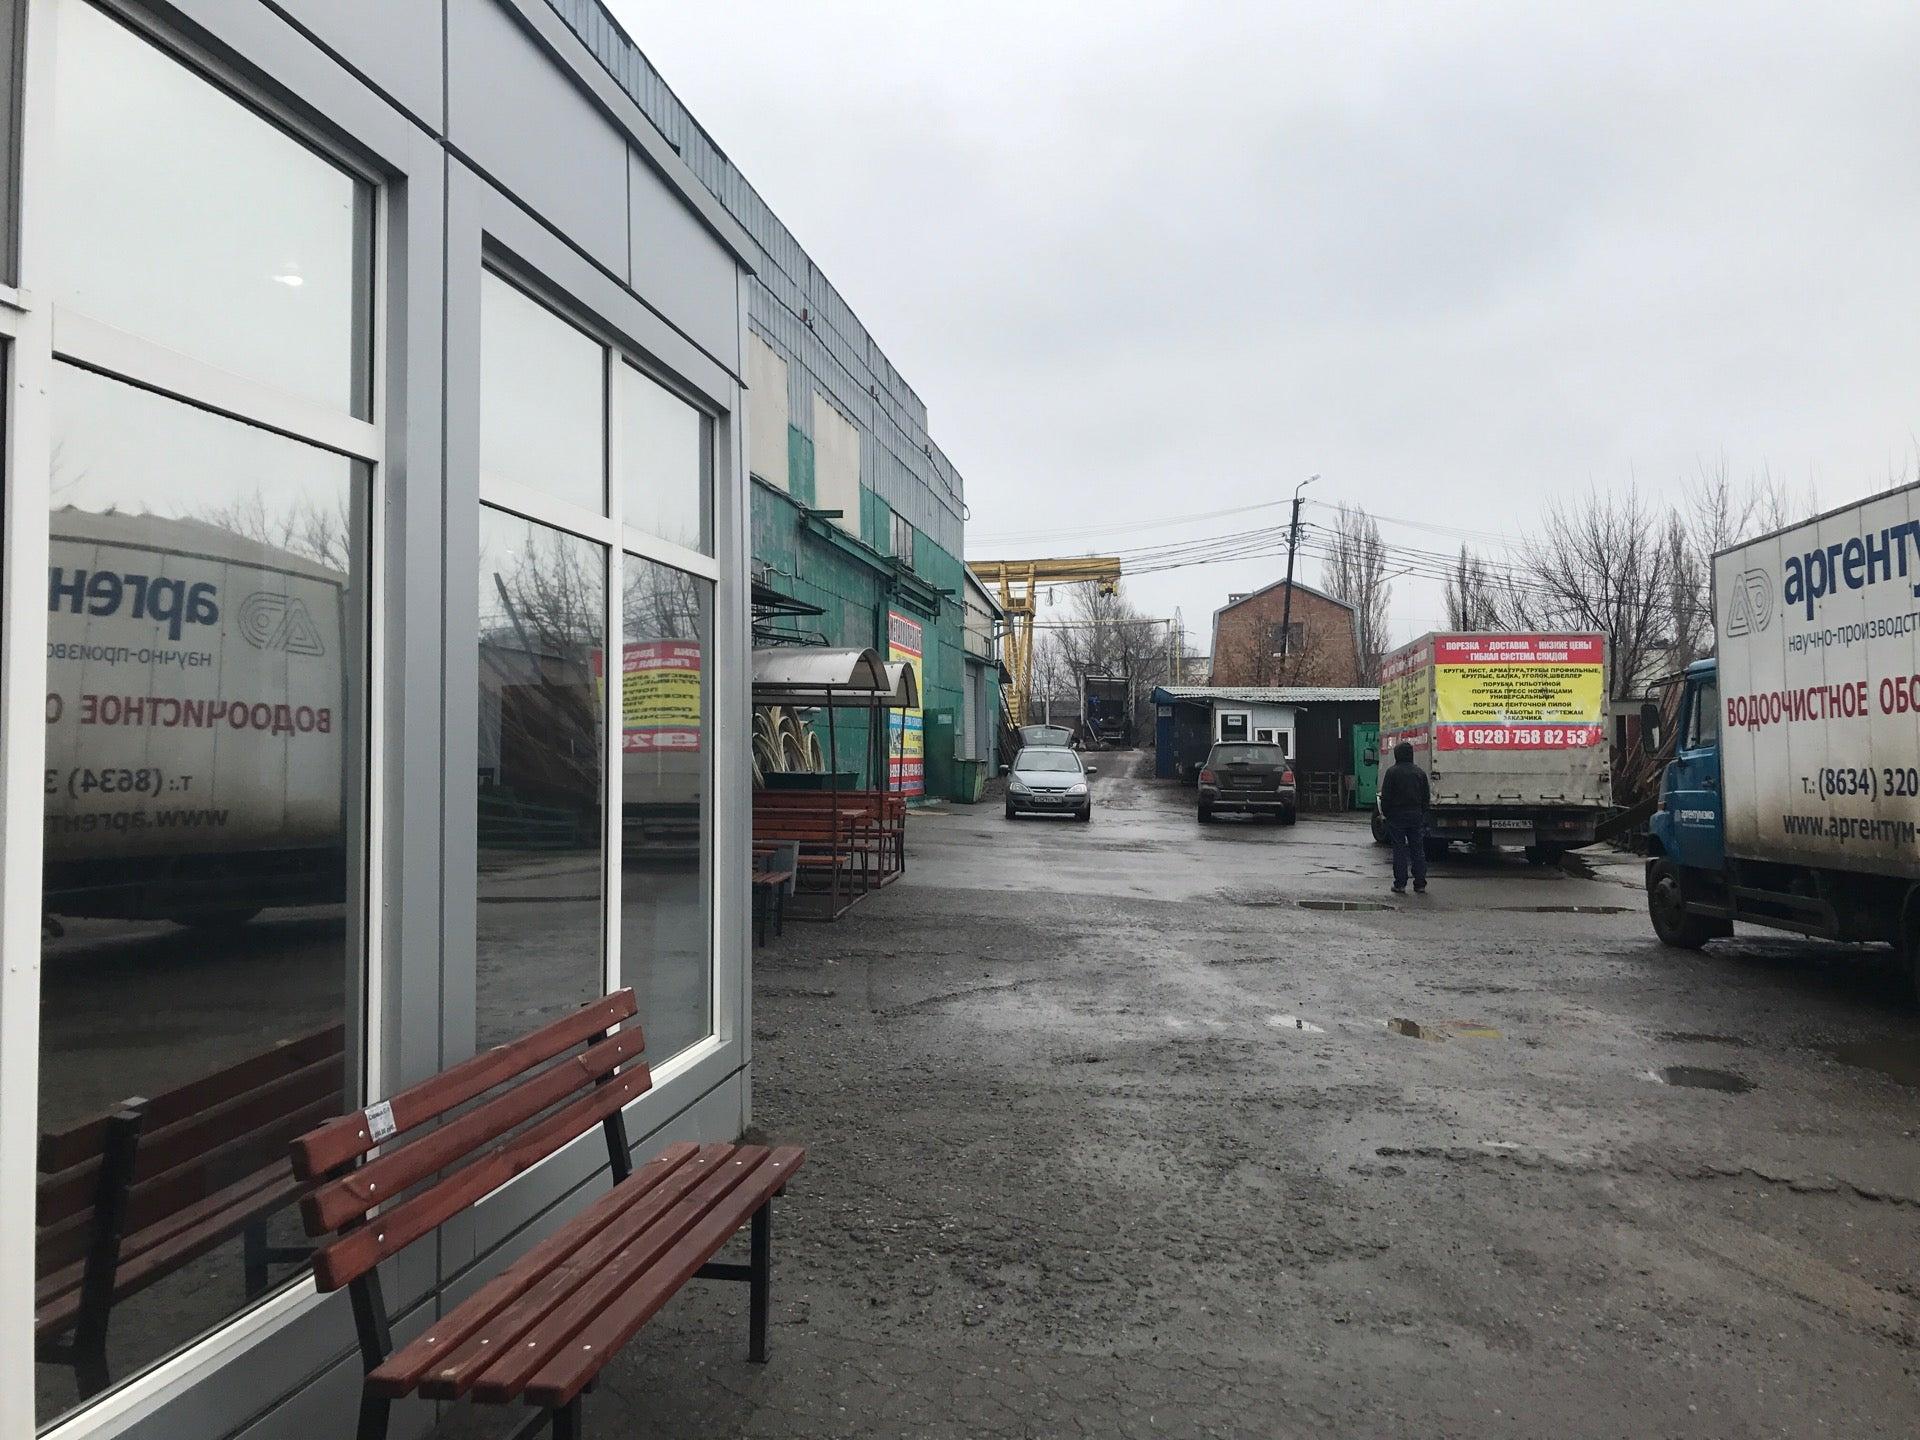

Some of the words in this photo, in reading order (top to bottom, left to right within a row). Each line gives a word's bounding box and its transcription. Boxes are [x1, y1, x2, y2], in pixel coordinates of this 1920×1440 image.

[1784, 520, 1920, 621] аргент
[1446, 642, 1480, 650] ПОРЕЗКА
[1489, 641, 1529, 651] ДОСТАВКА
[1539, 641, 1568, 650] НИЗКИЕ
[1569, 641, 1591, 651] ЦЕНЫ
[1788, 612, 1920, 656] научно-производст
[1470, 652, 1498, 661] ГИБКАЯ
[1500, 652, 1535, 661] СИСТЕМА
[1536, 652, 1567, 662] СКИДОК
[1727, 681, 1868, 732] ВОДООЧИСТНОЕ
[1455, 729, 1465, 744] 8
[1468, 729, 1509, 744] (928)
[1513, 729, 1540, 744] 758
[1544, 729, 1563, 744] 82
[1567, 729, 1587, 744] 53
[1818, 767, 1878, 802] (8634)
[1884, 767, 1919, 797] 320
